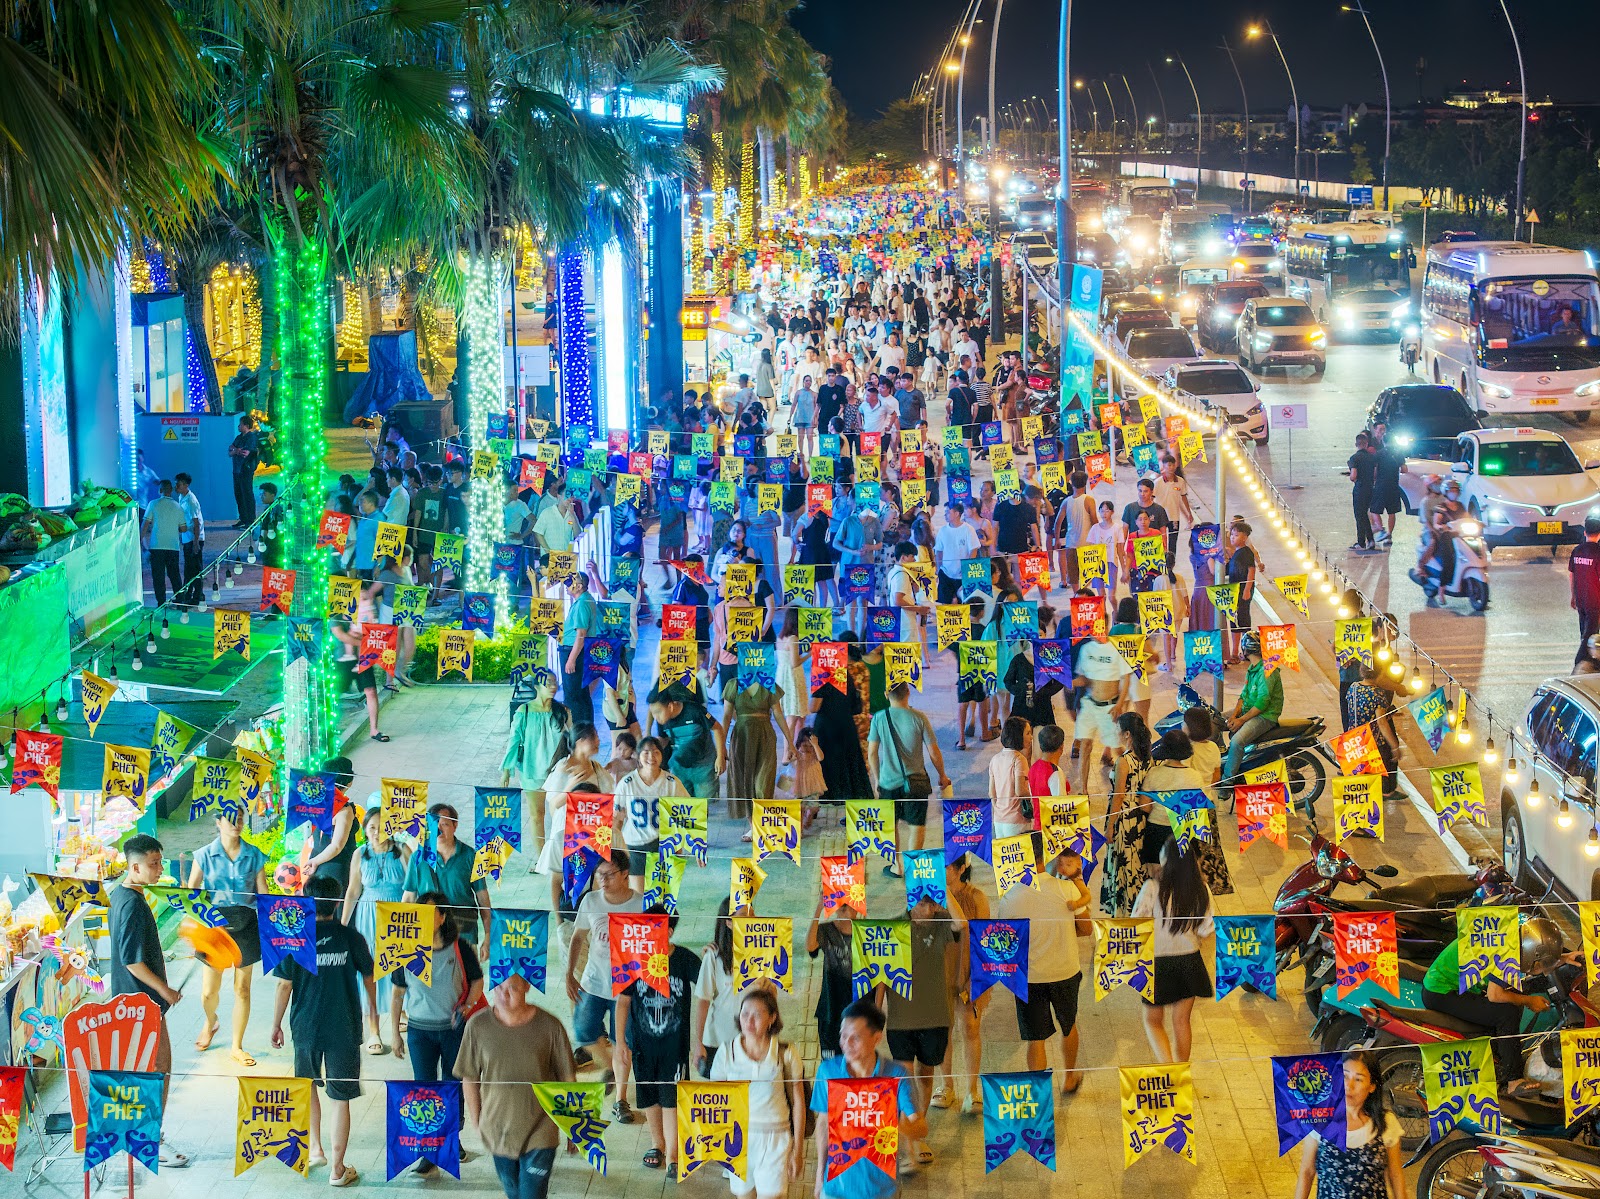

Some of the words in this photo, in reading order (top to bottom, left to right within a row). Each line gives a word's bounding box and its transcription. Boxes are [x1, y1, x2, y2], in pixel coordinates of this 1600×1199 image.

[271, 572, 286, 583] ĐẸP
[791, 576, 808, 584] PHẾT
[268, 579, 287, 591] PHẾT
[336, 582, 352, 590] NGON
[334, 588, 353, 598] PHẾT
[404, 590, 416, 600] SAY
[1214, 588, 1231, 598] SAY
[402, 598, 420, 608] PHẾT
[1214, 595, 1234, 606] PHẾT
[670, 611, 687, 619] ĐẸP
[1078, 604, 1095, 614] ĐẸP
[223, 614, 242, 622] CHILL
[668, 618, 688, 628] PHẾT
[807, 614, 822, 622] SAY
[1077, 612, 1098, 621] PHẾT
[222, 621, 242, 632] PHẾT
[805, 621, 826, 630] PHẾT
[1346, 624, 1362, 632] SAY
[369, 630, 386, 640] ĐẸP
[1266, 630, 1285, 642] ĐẸP
[1343, 632, 1365, 642] PHẾT
[367, 638, 388, 648] PHẾT
[444, 642, 465, 652] PHẾT
[521, 640, 538, 650] SAY
[1194, 637, 1212, 647] VUI
[1266, 640, 1288, 650] PHẾT
[519, 649, 540, 660] PHẾT
[669, 646, 687, 655] CHILL
[746, 648, 763, 660] VUI
[820, 648, 838, 658] ĐẸP
[969, 647, 986, 656] SAY
[1192, 644, 1214, 655] PHẾT
[668, 653, 687, 663] PHẾT
[744, 657, 766, 668] PHẾT
[818, 656, 839, 668] PHẾT
[892, 654, 913, 664] PHẾT
[967, 654, 989, 665] PHẾT
[164, 721, 181, 735] SAY
[158, 729, 179, 748] PHẾT
[1343, 737, 1362, 750] ĐẸP
[27, 740, 49, 752] ĐẸP
[24, 751, 50, 764] PHẾT
[114, 752, 136, 762] NGON
[1345, 746, 1369, 763] PHẾT
[112, 760, 138, 774] PHẾT
[207, 766, 226, 777] SAY
[203, 776, 231, 790] PHẾT
[1256, 770, 1277, 784] NGON
[1444, 772, 1464, 785] SAY
[394, 786, 416, 798] CHILL
[1344, 784, 1368, 792] NGON
[1442, 782, 1471, 798] PHẾT
[391, 796, 418, 809] PHẾT
[487, 796, 507, 808] VUI
[1246, 792, 1270, 804] ĐẸP
[1343, 791, 1369, 805] PHẾT
[484, 806, 511, 818] PHẾT
[578, 800, 600, 814] ĐẸP
[671, 806, 692, 817] SAY
[859, 808, 880, 819] SAY
[1052, 802, 1077, 815] CHILL
[1246, 803, 1274, 817] PHẾT
[574, 812, 602, 826] PHẾT
[668, 814, 697, 829] PHẾT
[762, 814, 788, 827] PHẾT
[856, 817, 885, 832] PHẾT
[1051, 812, 1078, 826] PHẾT
[1001, 842, 1021, 854] CHILL
[914, 858, 932, 869] VUI
[1001, 851, 1024, 864] PHẾT
[654, 861, 672, 872] SAY
[830, 864, 850, 876] ĐẸP
[913, 867, 936, 879] PHẾT
[652, 870, 673, 884] PHẾT
[829, 873, 854, 886] PHẾT
[390, 911, 420, 924] CHILL
[387, 923, 421, 940] PHẾT
[506, 919, 531, 932] VUI
[746, 923, 774, 933] NGON
[1348, 923, 1377, 938] ĐẸP
[1474, 918, 1501, 932] SAY
[622, 924, 651, 940] ĐẸP
[866, 927, 892, 941] SAY
[1110, 926, 1140, 939] CHILL
[1229, 927, 1256, 940] VUI
[502, 931, 536, 949] PHẾT
[620, 936, 656, 954] PHẾT
[744, 932, 778, 948] PHẾT
[1108, 938, 1142, 954] PHẾT
[1346, 936, 1382, 954] PHẾT
[1471, 932, 1507, 948] PHẾT
[862, 940, 898, 957] PHẾT
[1227, 938, 1261, 956] PHẾT
[77, 1012, 112, 1035] Kem
[114, 996, 146, 1022] Ống
[1441, 1051, 1472, 1067] SAY
[1138, 1073, 1174, 1091] CHILL
[1439, 1067, 1479, 1088] PHẾT
[108, 1086, 139, 1103] VUI
[256, 1088, 294, 1105] CHILL
[1000, 1083, 1032, 1102] VUI
[554, 1092, 587, 1110] SAY
[693, 1093, 728, 1106] NGON
[845, 1092, 879, 1109] ĐẸP
[1137, 1091, 1178, 1109] PHẾT
[103, 1100, 146, 1120] PHẾT
[252, 1104, 295, 1123] PHẾT
[691, 1105, 731, 1124] PHẾT
[998, 1100, 1039, 1120] PHẾT
[842, 1108, 885, 1127] PHẾT
